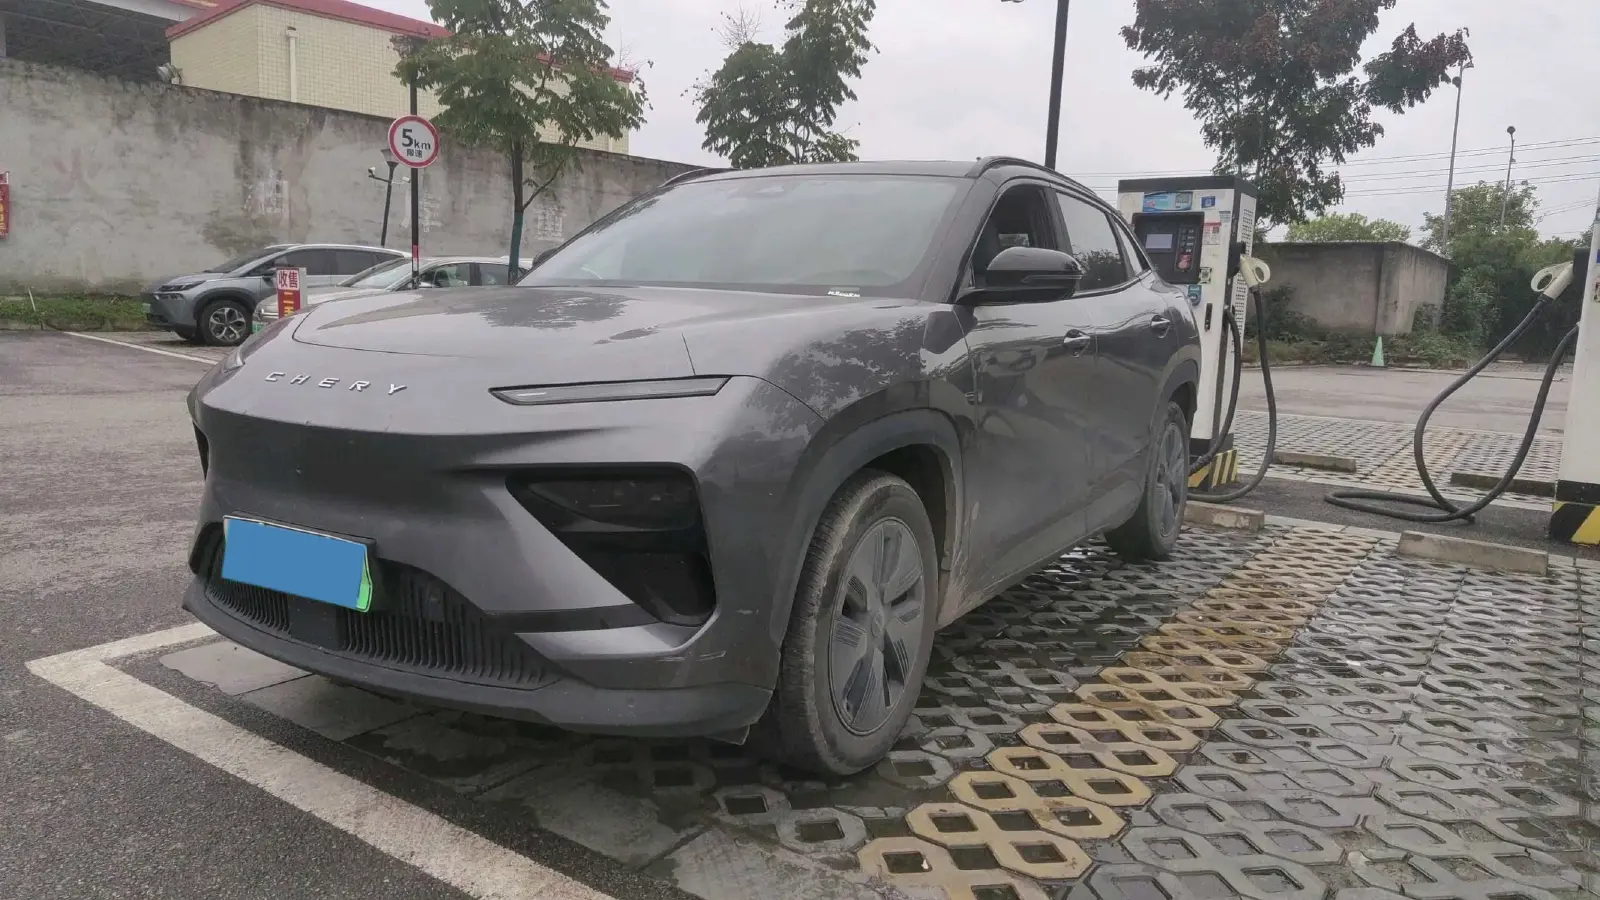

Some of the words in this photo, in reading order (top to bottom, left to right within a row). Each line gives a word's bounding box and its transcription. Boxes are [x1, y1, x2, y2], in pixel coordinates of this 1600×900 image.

[402, 128, 431, 150] 5km
[278, 270, 298, 288] 收售
[265, 371, 408, 395] CHERY
